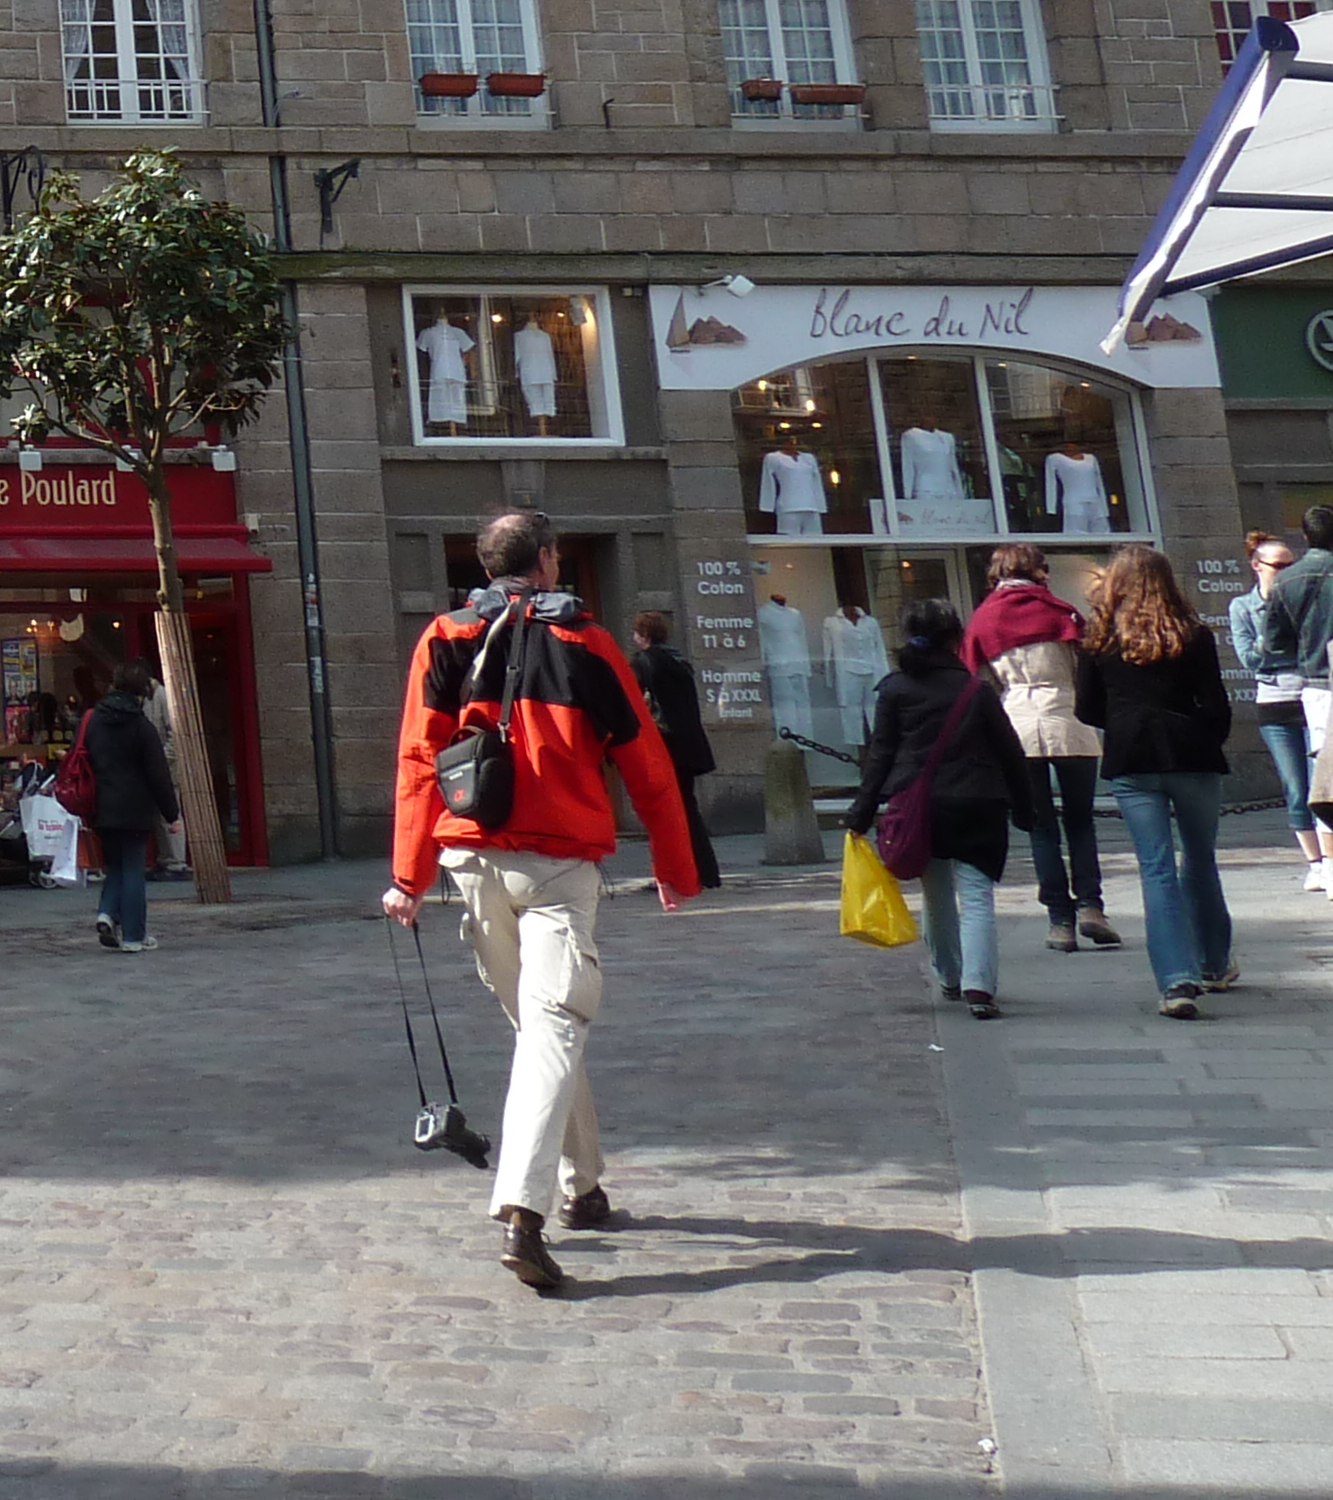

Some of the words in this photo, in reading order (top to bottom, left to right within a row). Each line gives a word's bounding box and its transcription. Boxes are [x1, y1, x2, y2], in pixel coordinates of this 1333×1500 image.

[924, 295, 968, 337] du
[978, 286, 1034, 339] Nil
[21, 468, 117, 506] Poulard
[697, 561, 723, 576] 100
[726, 561, 742, 576] %
[1196, 560, 1222, 574] 100
[1225, 559, 1241, 574] %
[698, 580, 745, 595] Coton
[1198, 579, 1244, 593] Coton
[697, 615, 754, 629] Femme
[723, 632, 733, 648] à
[737, 634, 746, 648] 6
[702, 669, 762, 684] Homme
[706, 688, 716, 703] S
